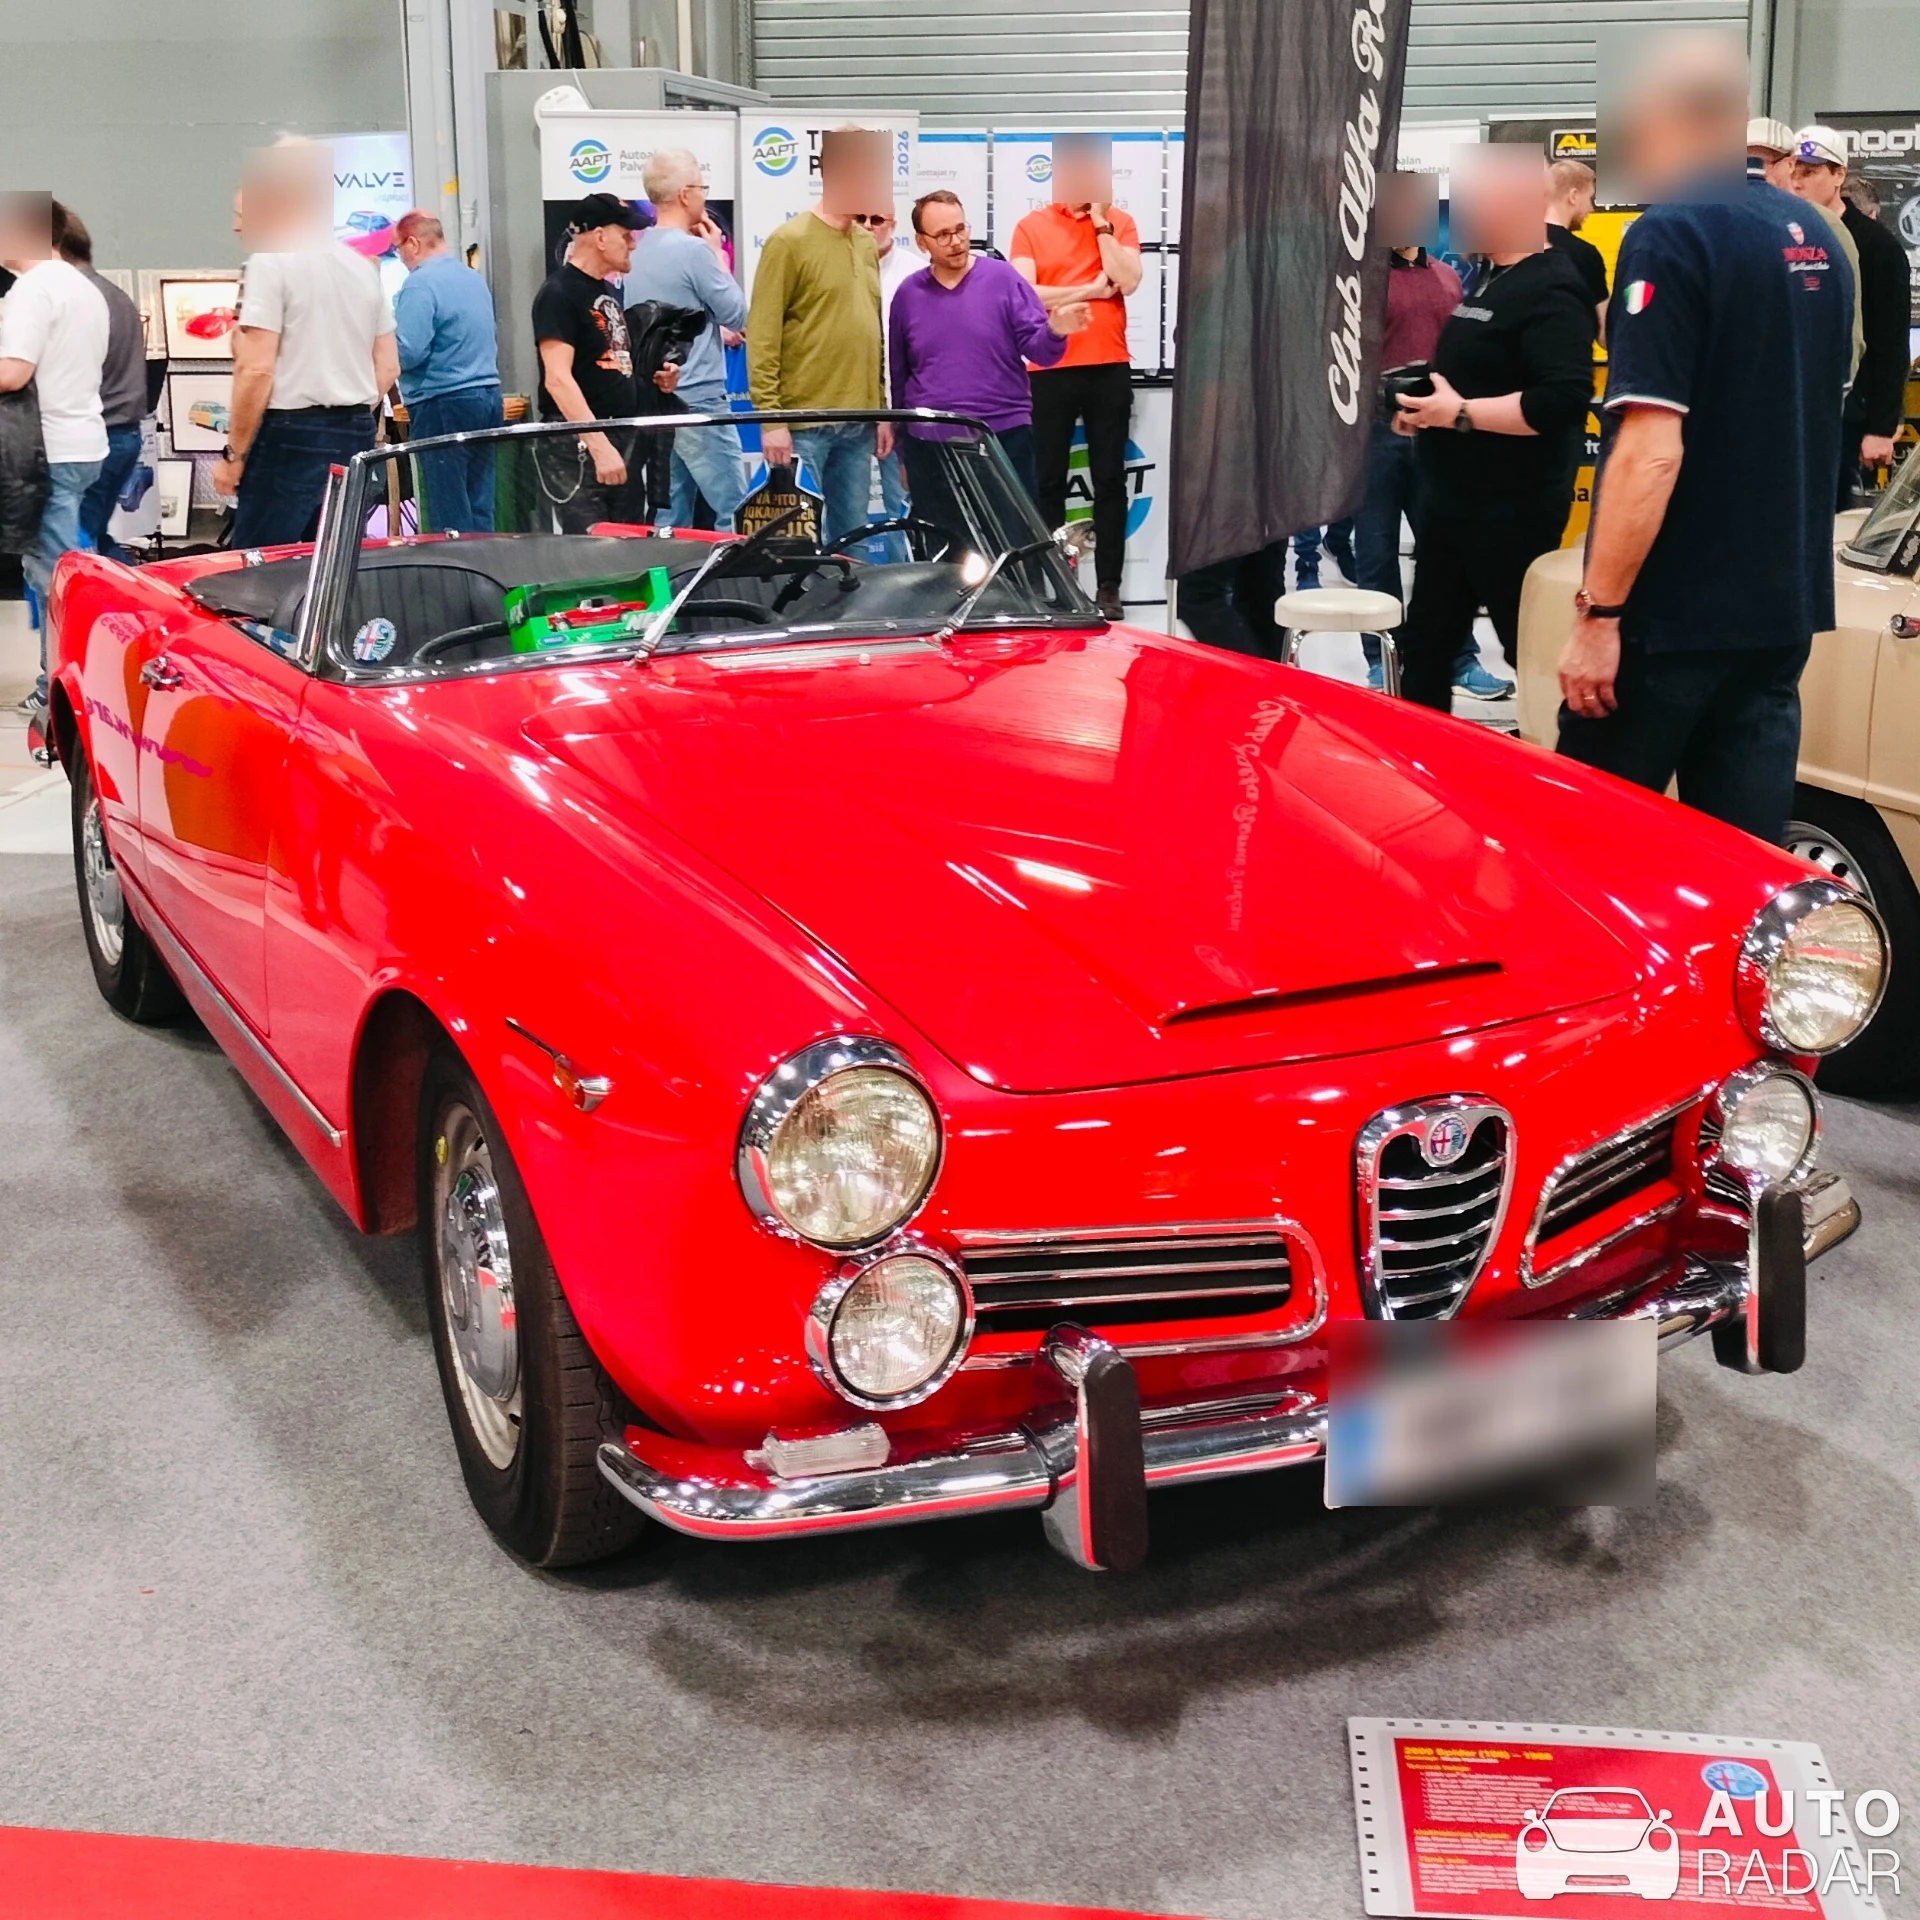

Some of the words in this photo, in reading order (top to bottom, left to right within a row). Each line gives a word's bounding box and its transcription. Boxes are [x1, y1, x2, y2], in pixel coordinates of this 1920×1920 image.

[569, 153, 612, 169] AAPT
[752, 142, 799, 160] AAPT
[897, 130, 909, 176] 2026
[334, 172, 405, 188] VALVE
[1340, 87, 1381, 262] Alfa
[1328, 269, 1362, 425] Club
